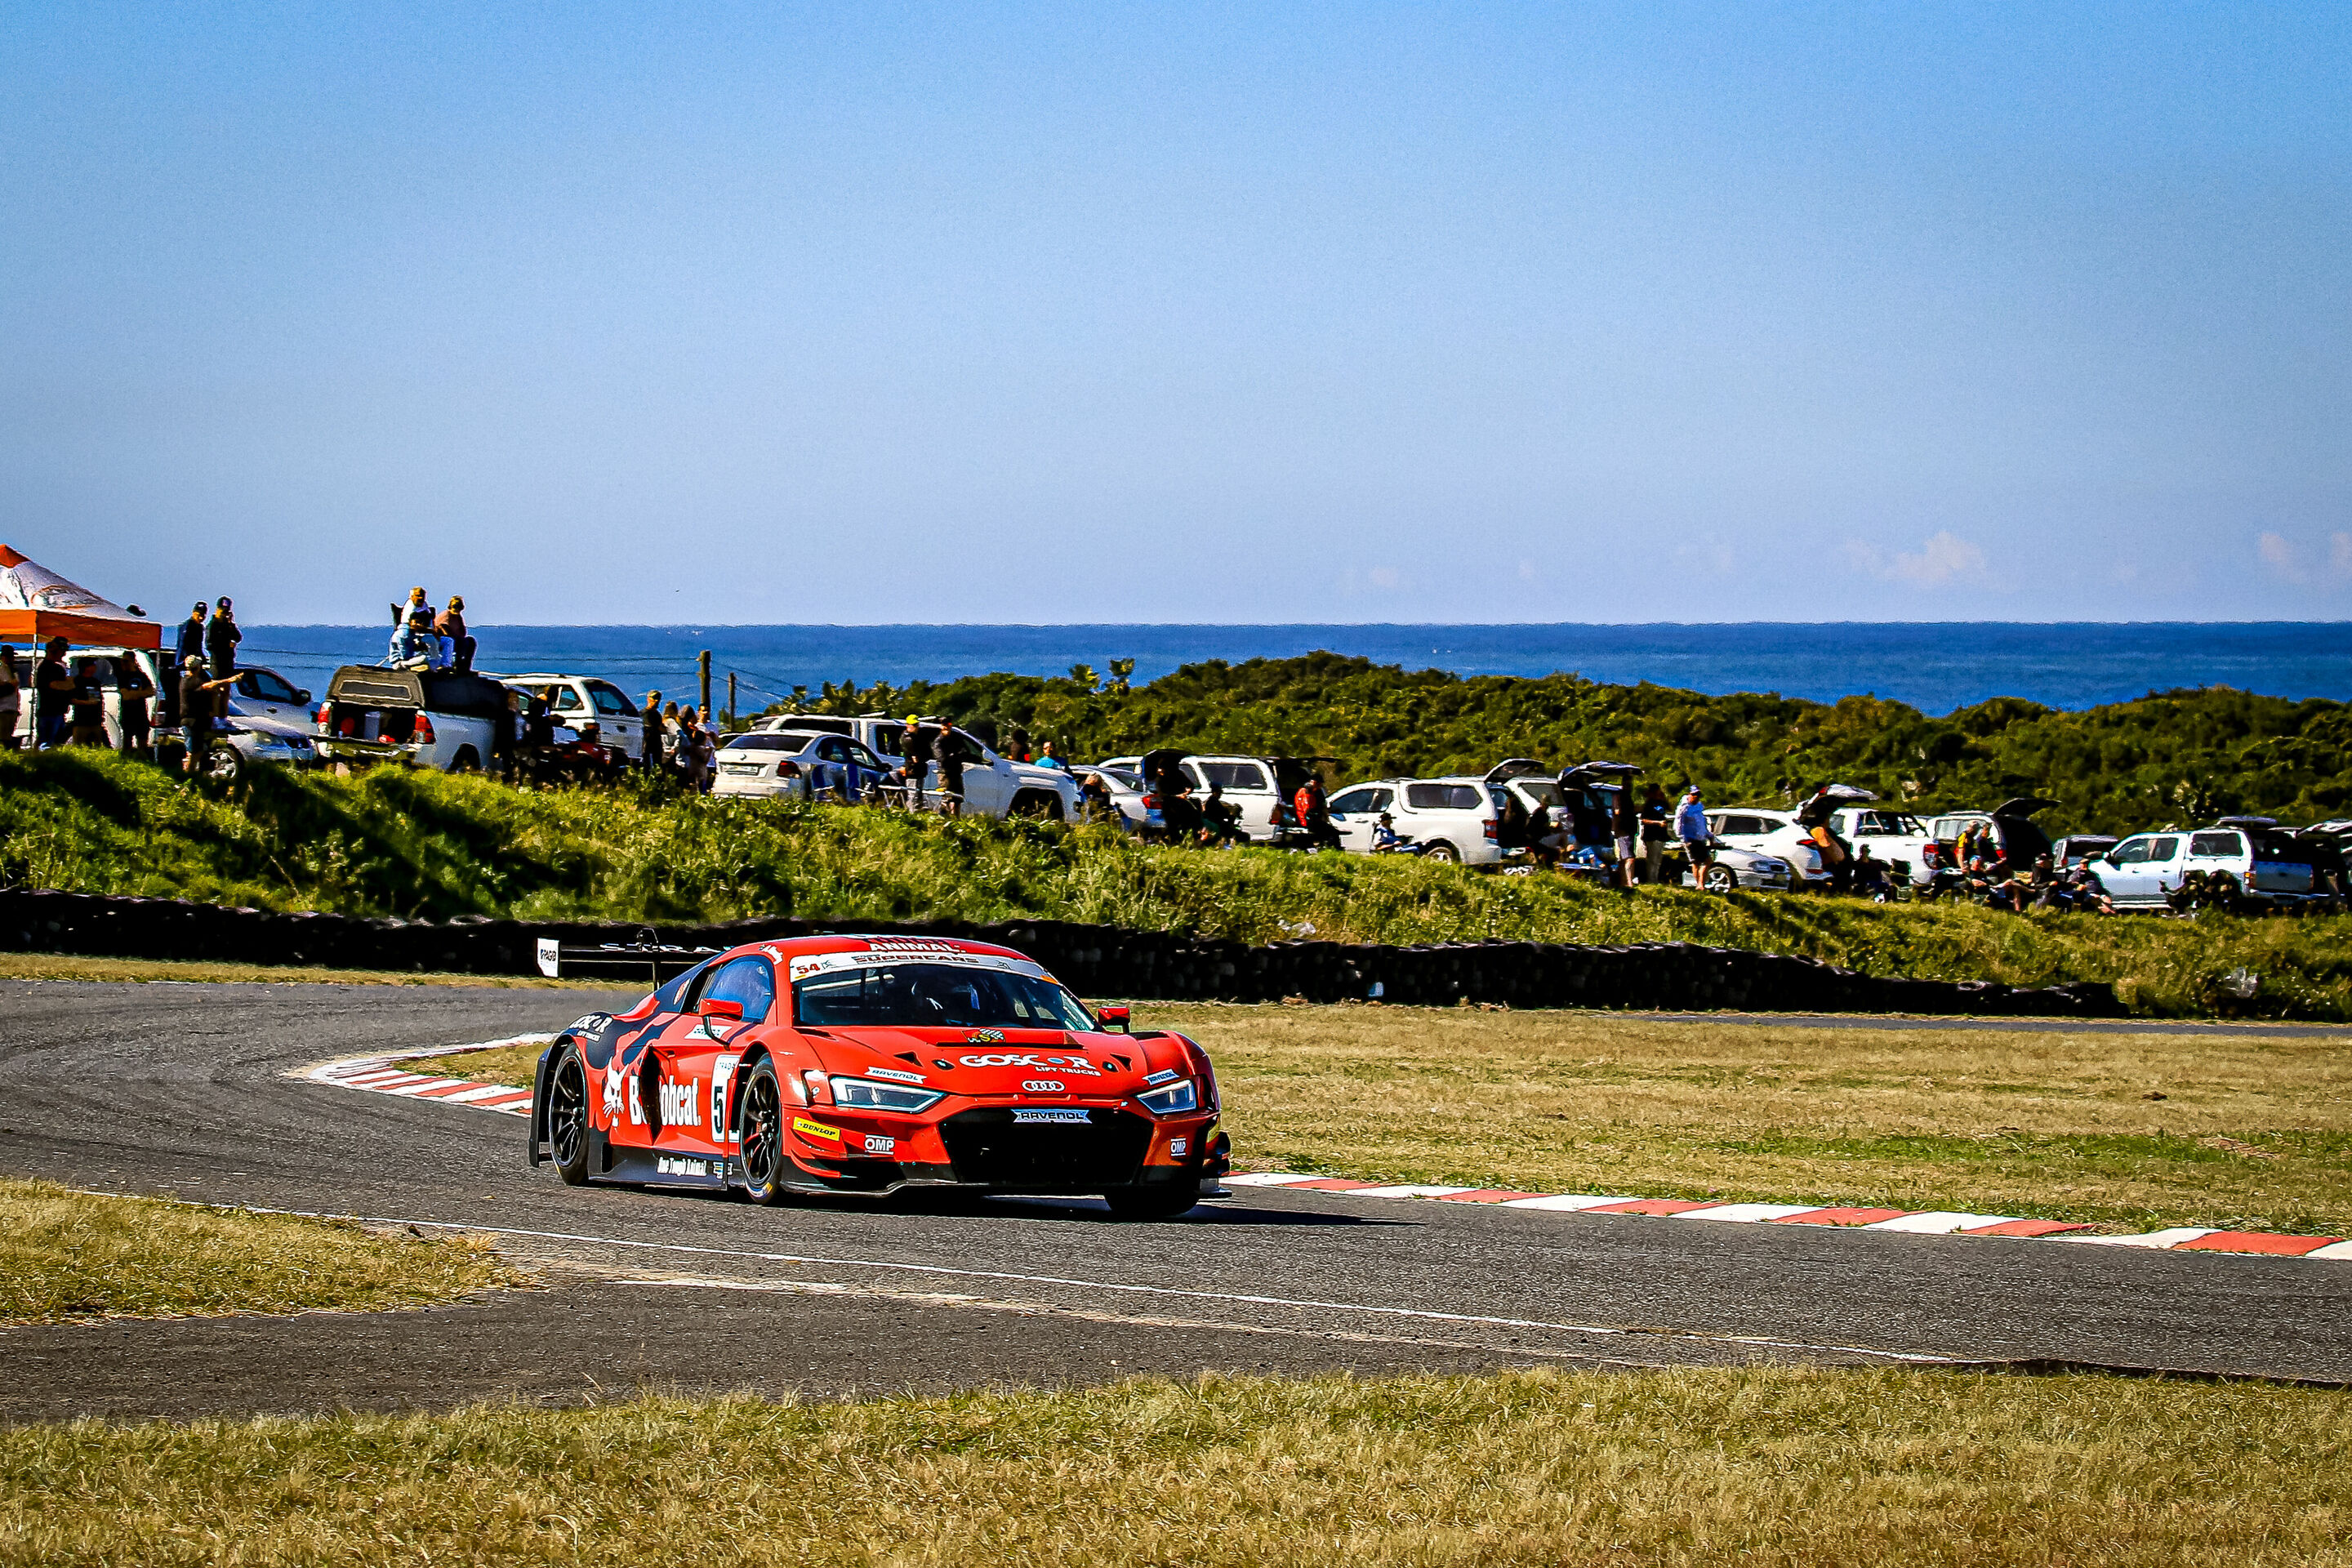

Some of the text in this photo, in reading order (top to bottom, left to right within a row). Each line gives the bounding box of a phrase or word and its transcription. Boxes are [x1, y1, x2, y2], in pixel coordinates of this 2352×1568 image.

[796, 964, 820, 973] 54
[959, 1054, 1097, 1070] GOSCOR
[872, 1069, 919, 1080] RAVENOL
[1059, 1067, 1102, 1076] TRUCKS
[1021, 1111, 1085, 1120] RAVENOL
[803, 1123, 836, 1136] DUNLOP
[864, 1138, 894, 1152] OMP
[1170, 1142, 1186, 1152] OMP
